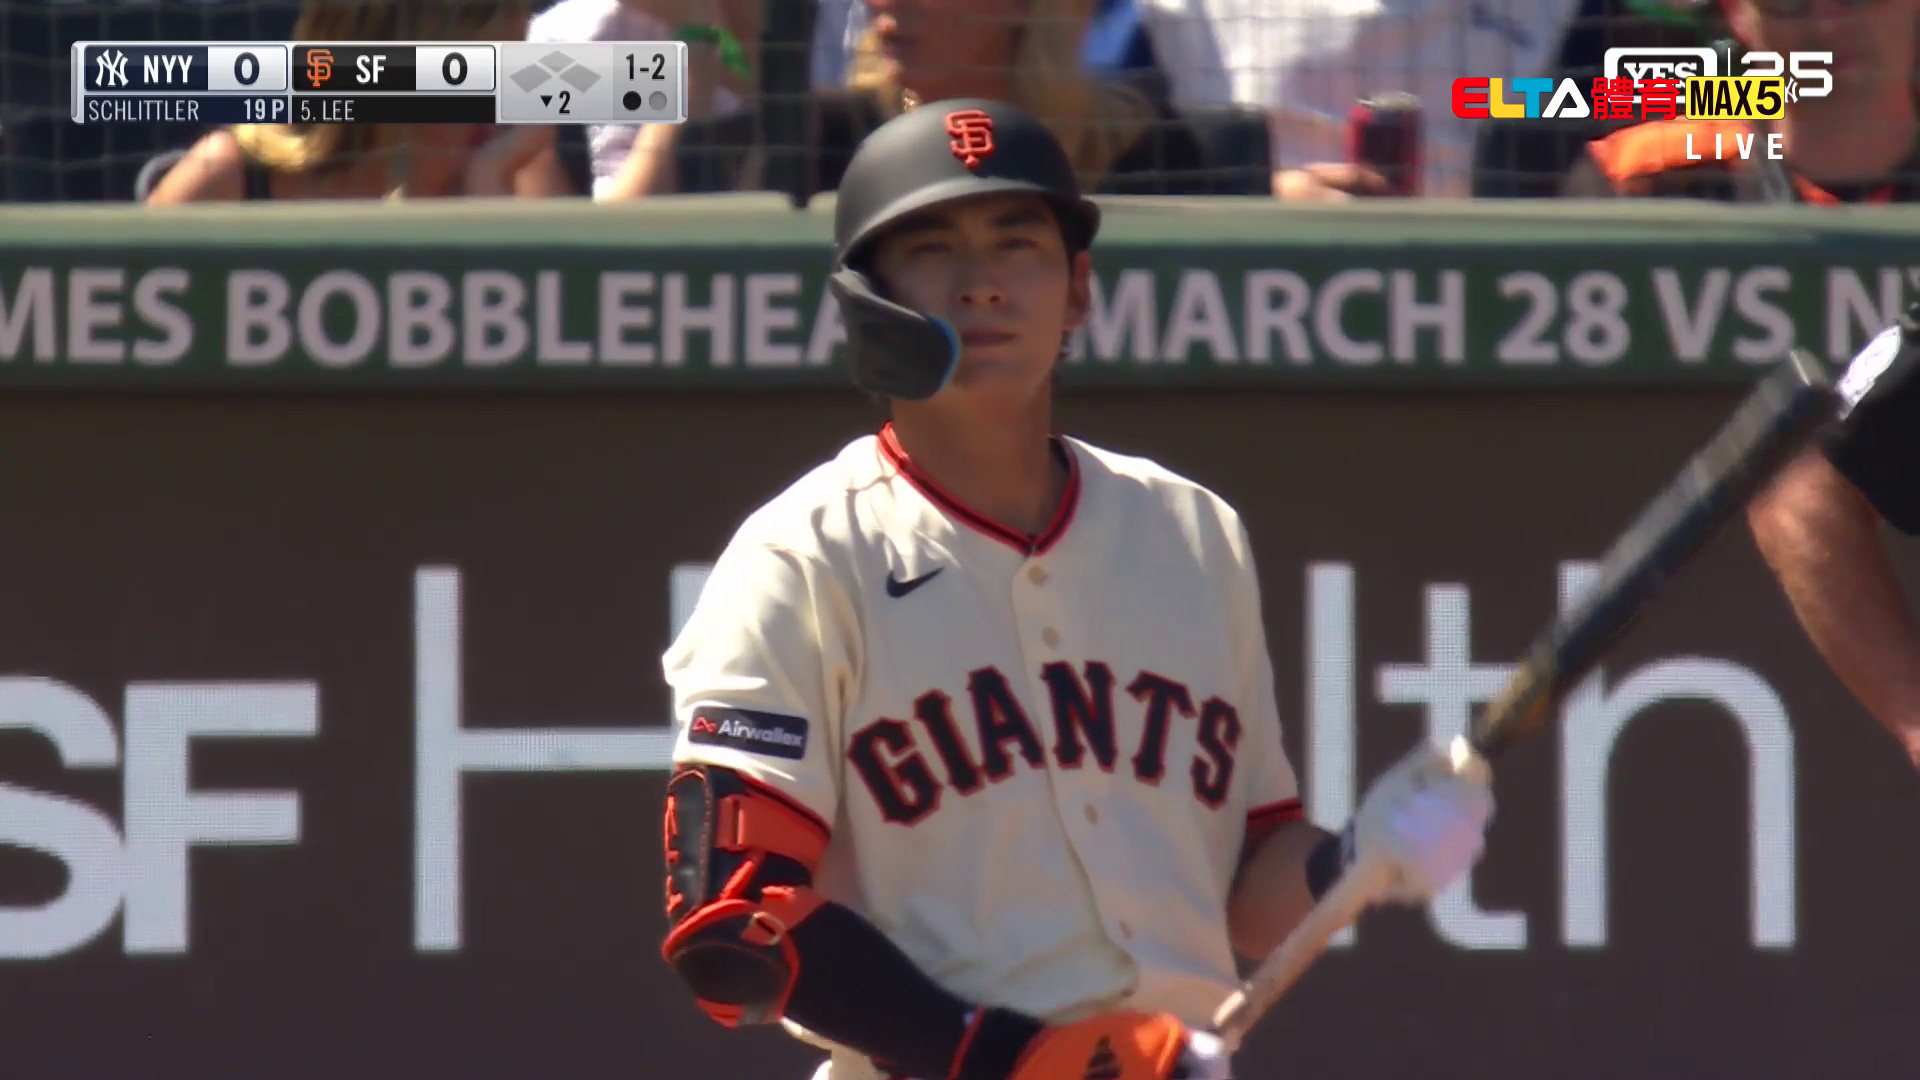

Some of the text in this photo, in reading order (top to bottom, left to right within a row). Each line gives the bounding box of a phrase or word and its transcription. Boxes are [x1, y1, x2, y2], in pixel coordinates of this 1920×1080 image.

[0, 266, 1920, 367] MES BOBBLEHEA MARCH 28 VS N
[718, 719, 804, 747] Airwallex
[847, 660, 1243, 828] GIANTS
